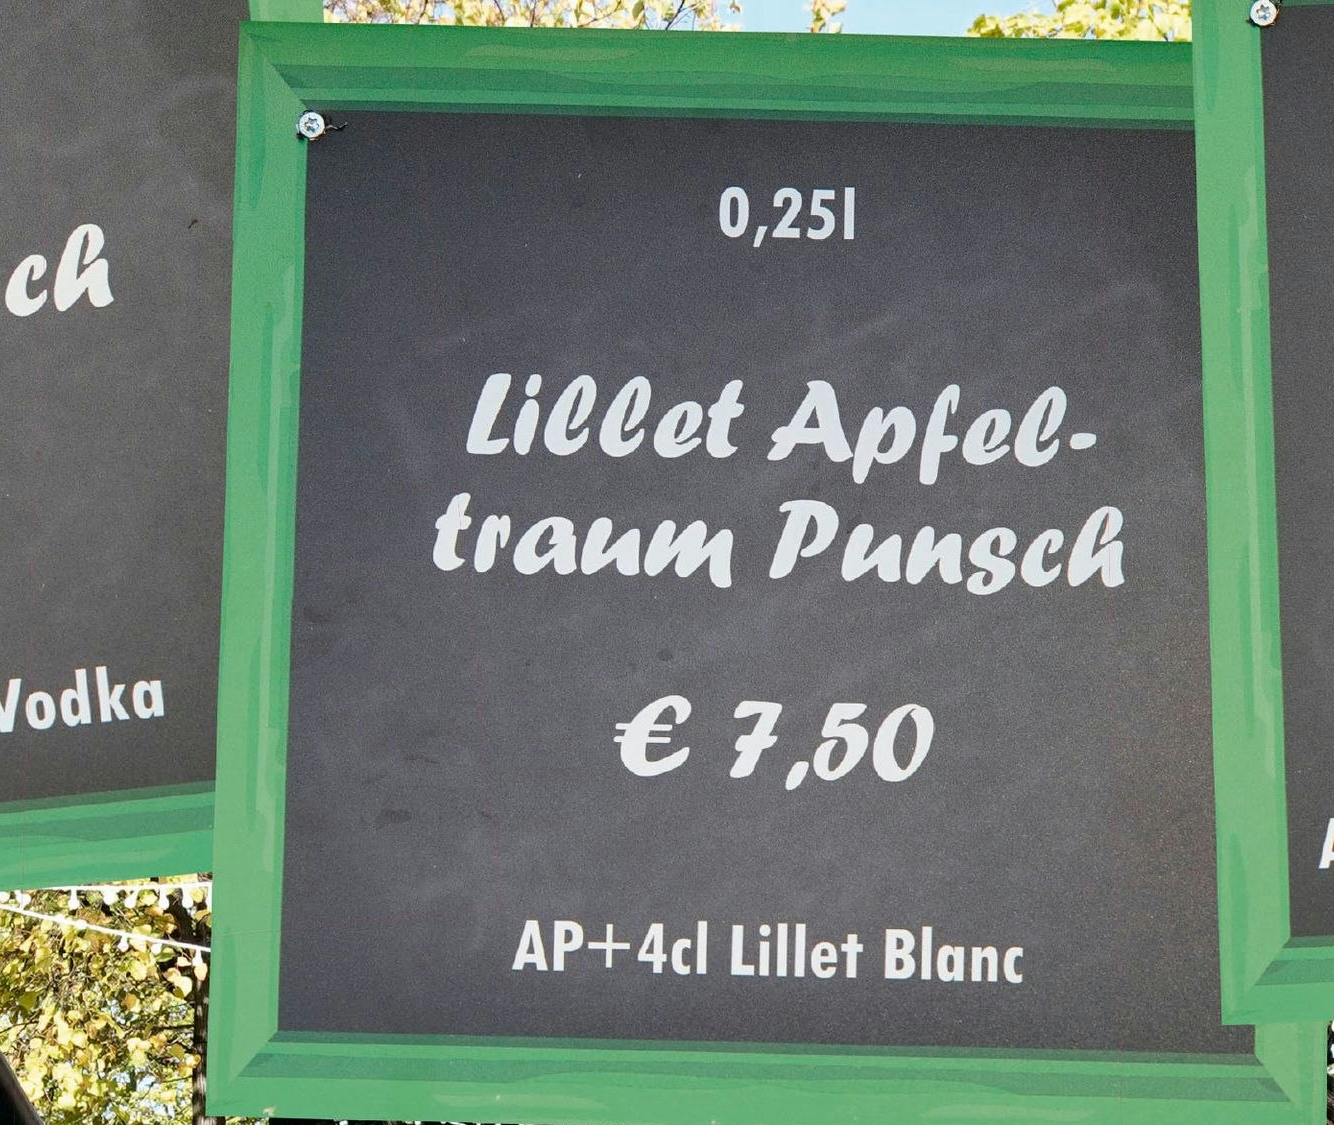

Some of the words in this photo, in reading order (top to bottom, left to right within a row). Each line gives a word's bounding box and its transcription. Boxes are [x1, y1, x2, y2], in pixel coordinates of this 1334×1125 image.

[718, 186, 856, 248] 0,25l
[465, 372, 745, 460] Lillet
[766, 379, 1097, 486] Apfel-
[432, 492, 734, 589] traum
[768, 499, 1126, 596] Punsch
[612, 694, 693, 778] €
[729, 699, 936, 791] 7,50
[511, 919, 708, 976] AP+4cl
[730, 922, 863, 980] Lillet
[884, 925, 1024, 984] Blanc
